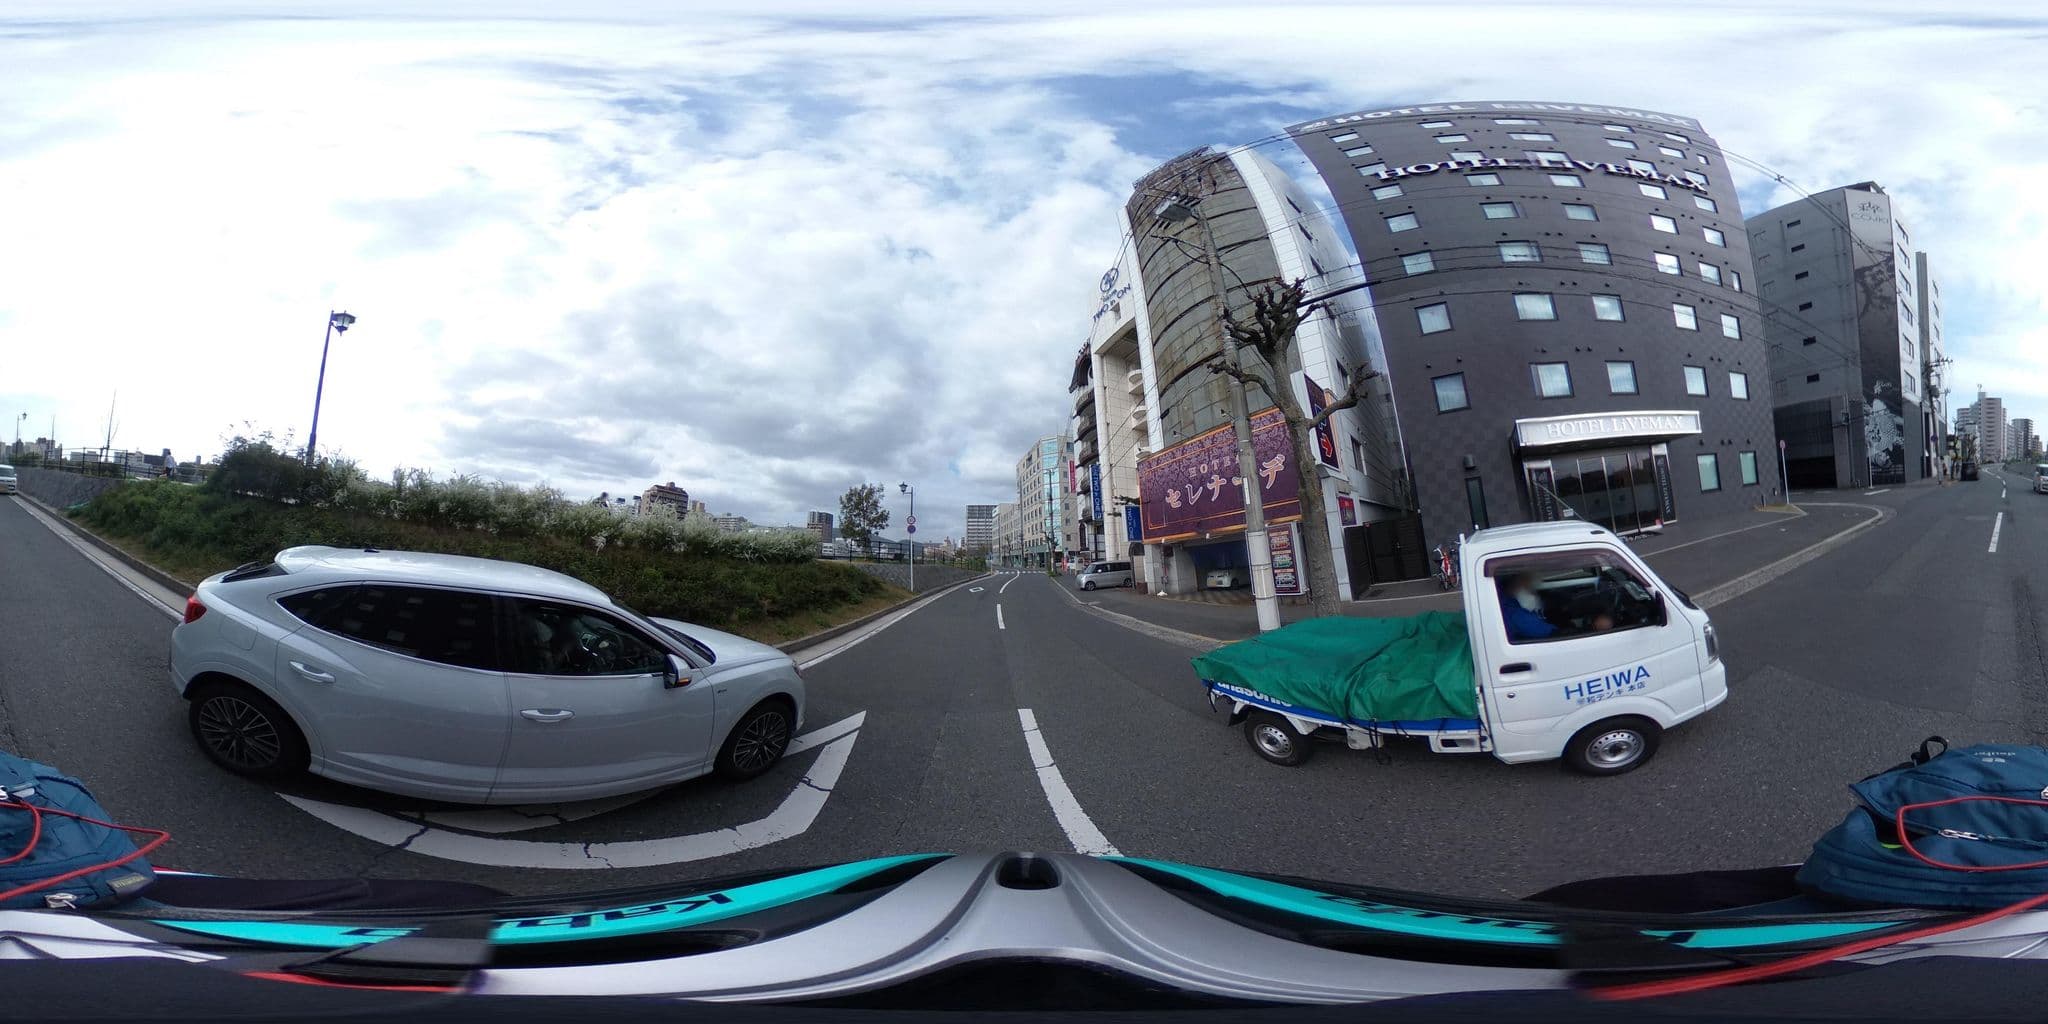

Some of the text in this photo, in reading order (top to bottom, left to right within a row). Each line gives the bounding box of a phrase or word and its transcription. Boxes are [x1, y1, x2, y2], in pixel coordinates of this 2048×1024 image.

[1334, 104, 1476, 124] HOTEL
[1373, 157, 1522, 181] HOTEL
[1093, 303, 1109, 323] TWO
[1117, 283, 1131, 299] ON
[1546, 418, 1610, 438] HOTEL
[1564, 665, 1651, 700] HEIWA
